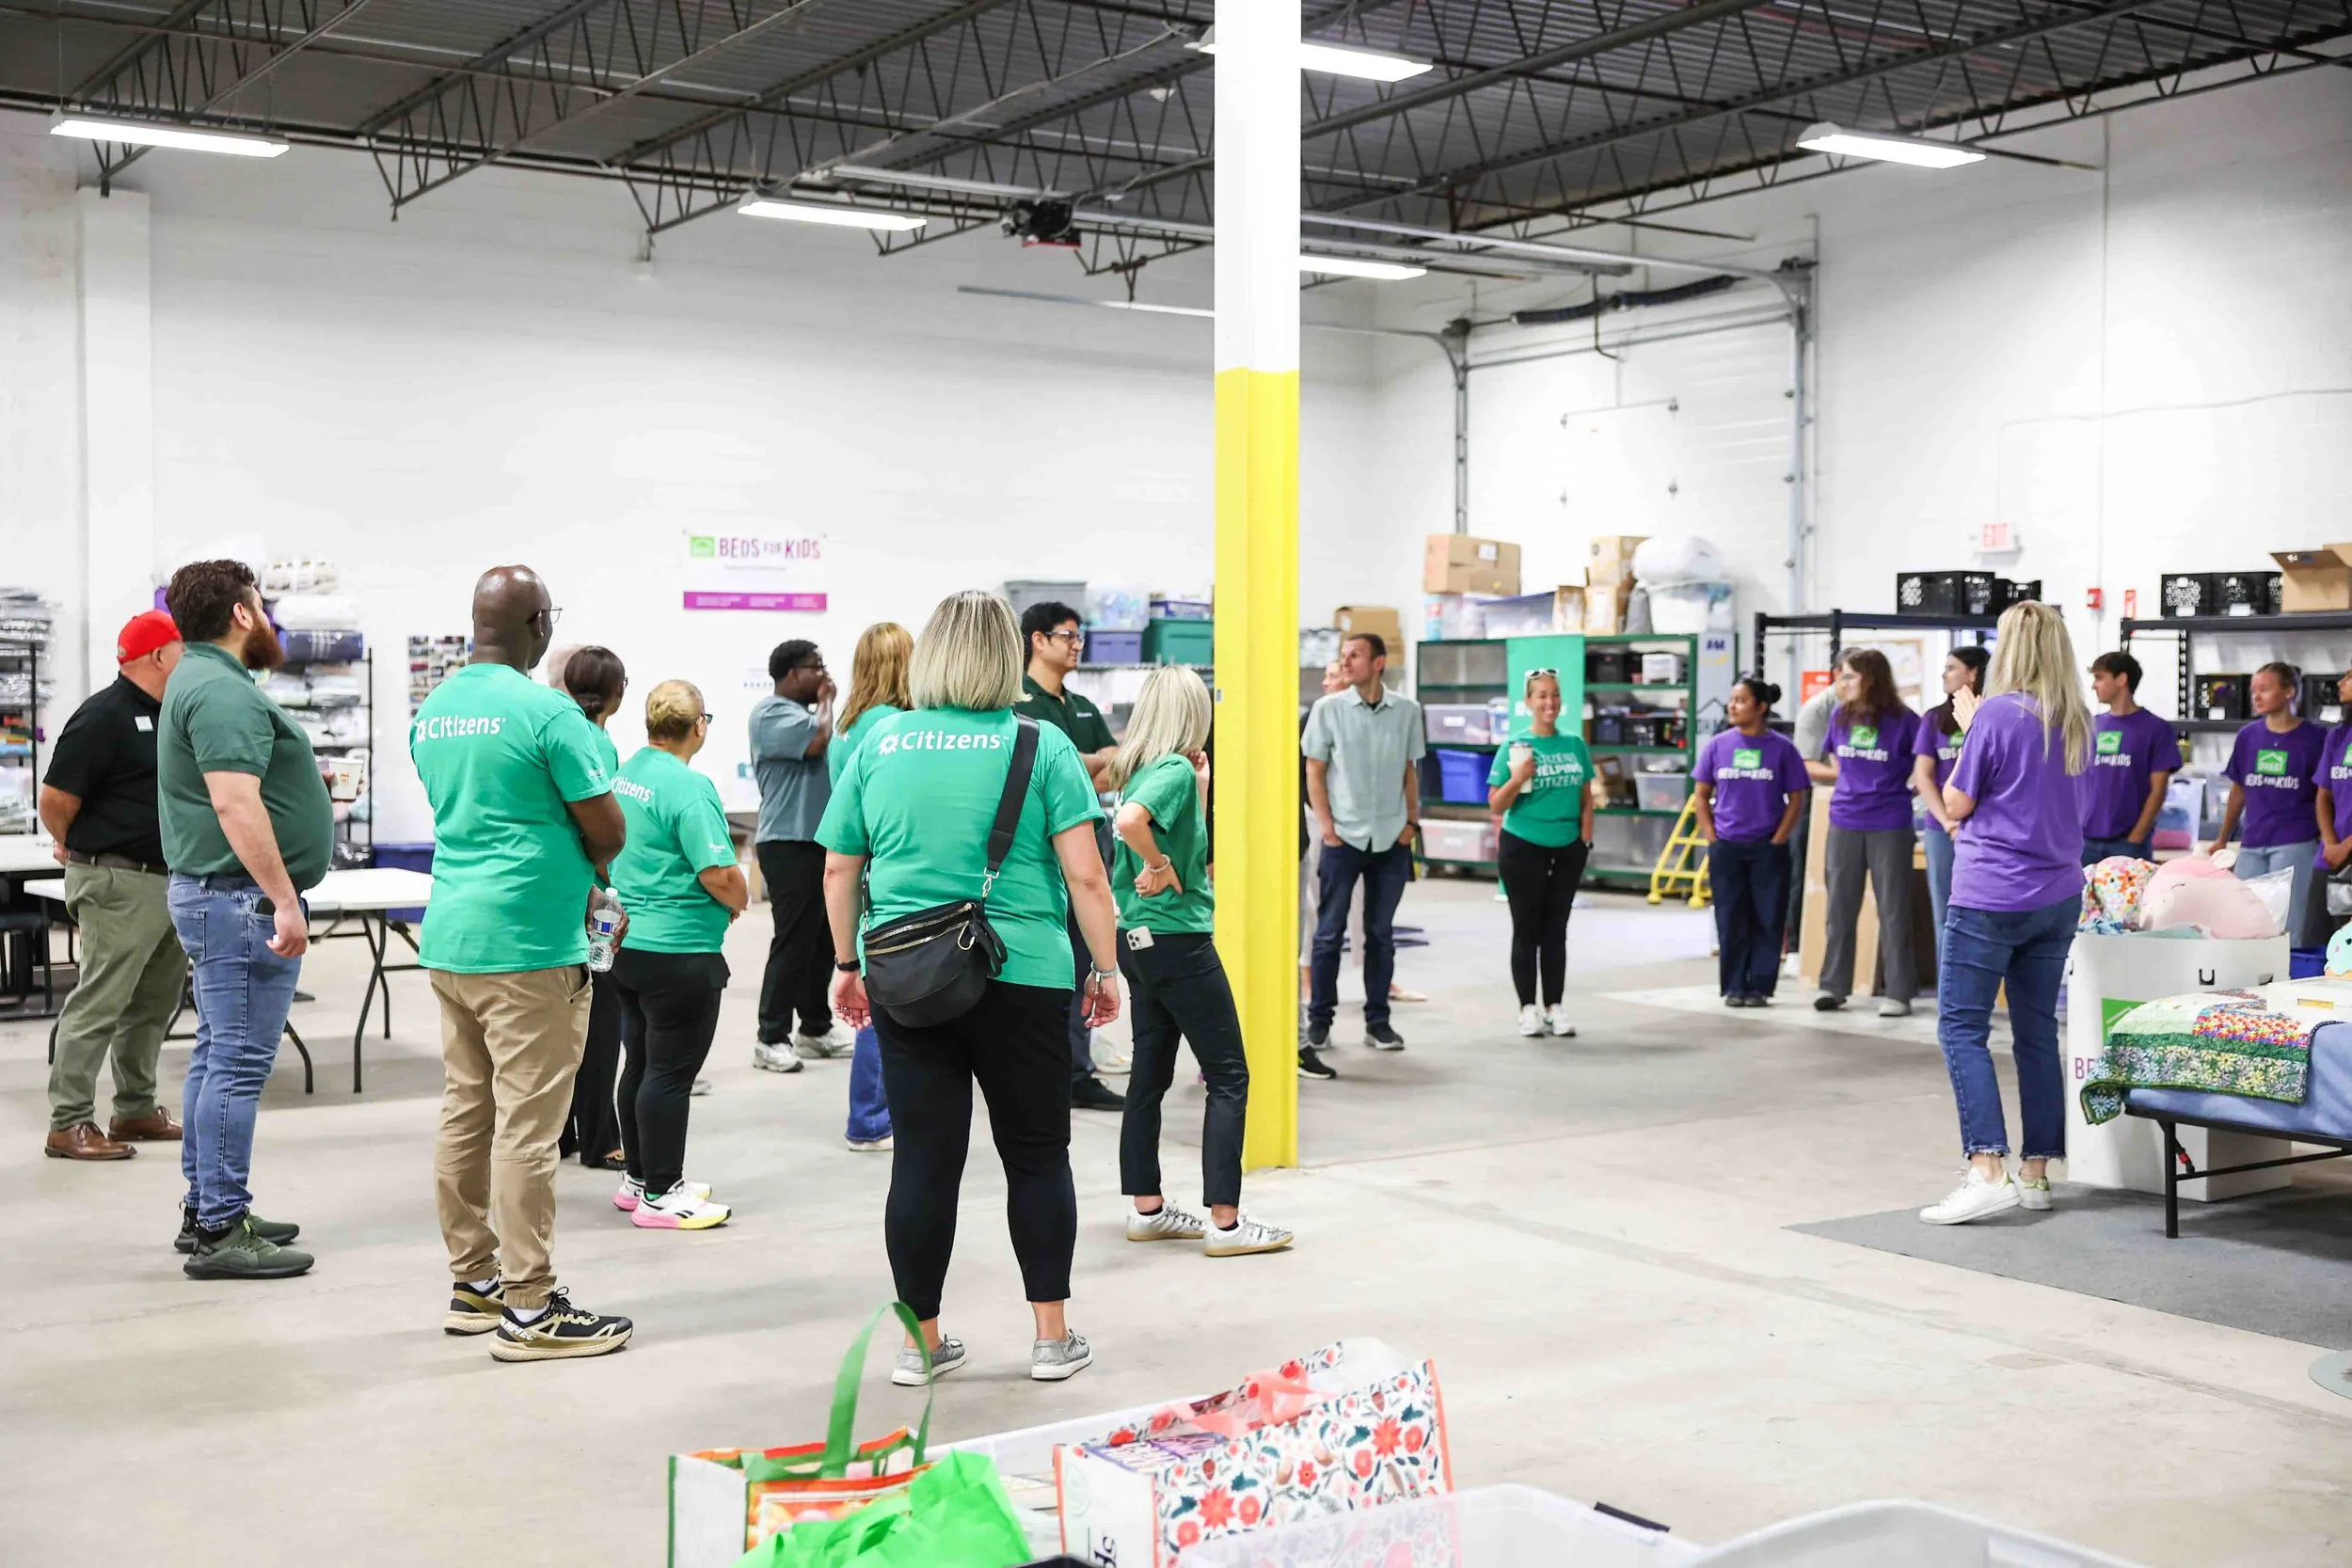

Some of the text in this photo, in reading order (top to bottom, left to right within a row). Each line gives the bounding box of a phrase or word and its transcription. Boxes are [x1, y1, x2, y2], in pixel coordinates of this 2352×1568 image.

[719, 537, 760, 559] BEDS
[785, 538, 821, 560] KIDS
[428, 715, 501, 738] Citizens
[901, 730, 1001, 750] Citizens
[611, 776, 652, 802] Citizens
